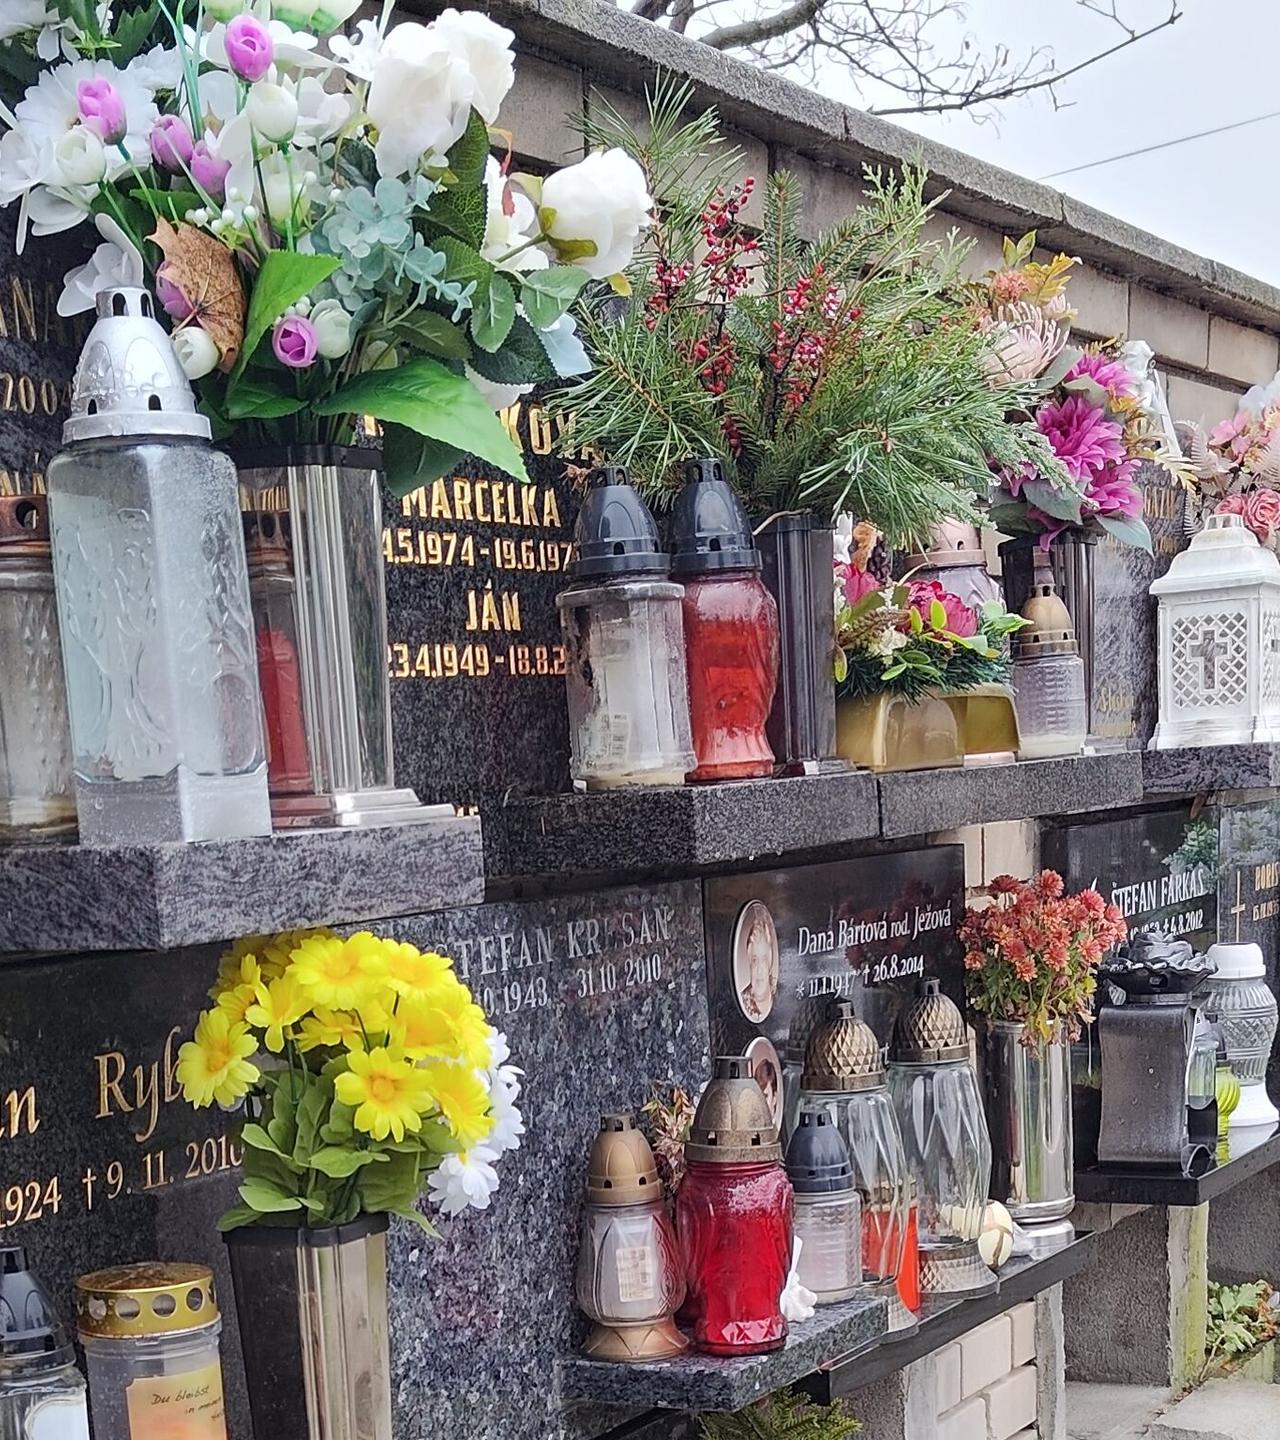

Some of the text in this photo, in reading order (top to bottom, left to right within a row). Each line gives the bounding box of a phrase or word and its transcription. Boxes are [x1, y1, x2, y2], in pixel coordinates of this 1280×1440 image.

[403, 477, 562, 528] MARCELKA
[466, 578, 521, 632] JÁN
[1111, 867, 1205, 921] ŠTEFAN FARKAS
[798, 899, 952, 957] Dana Bártová rod. Ježová
